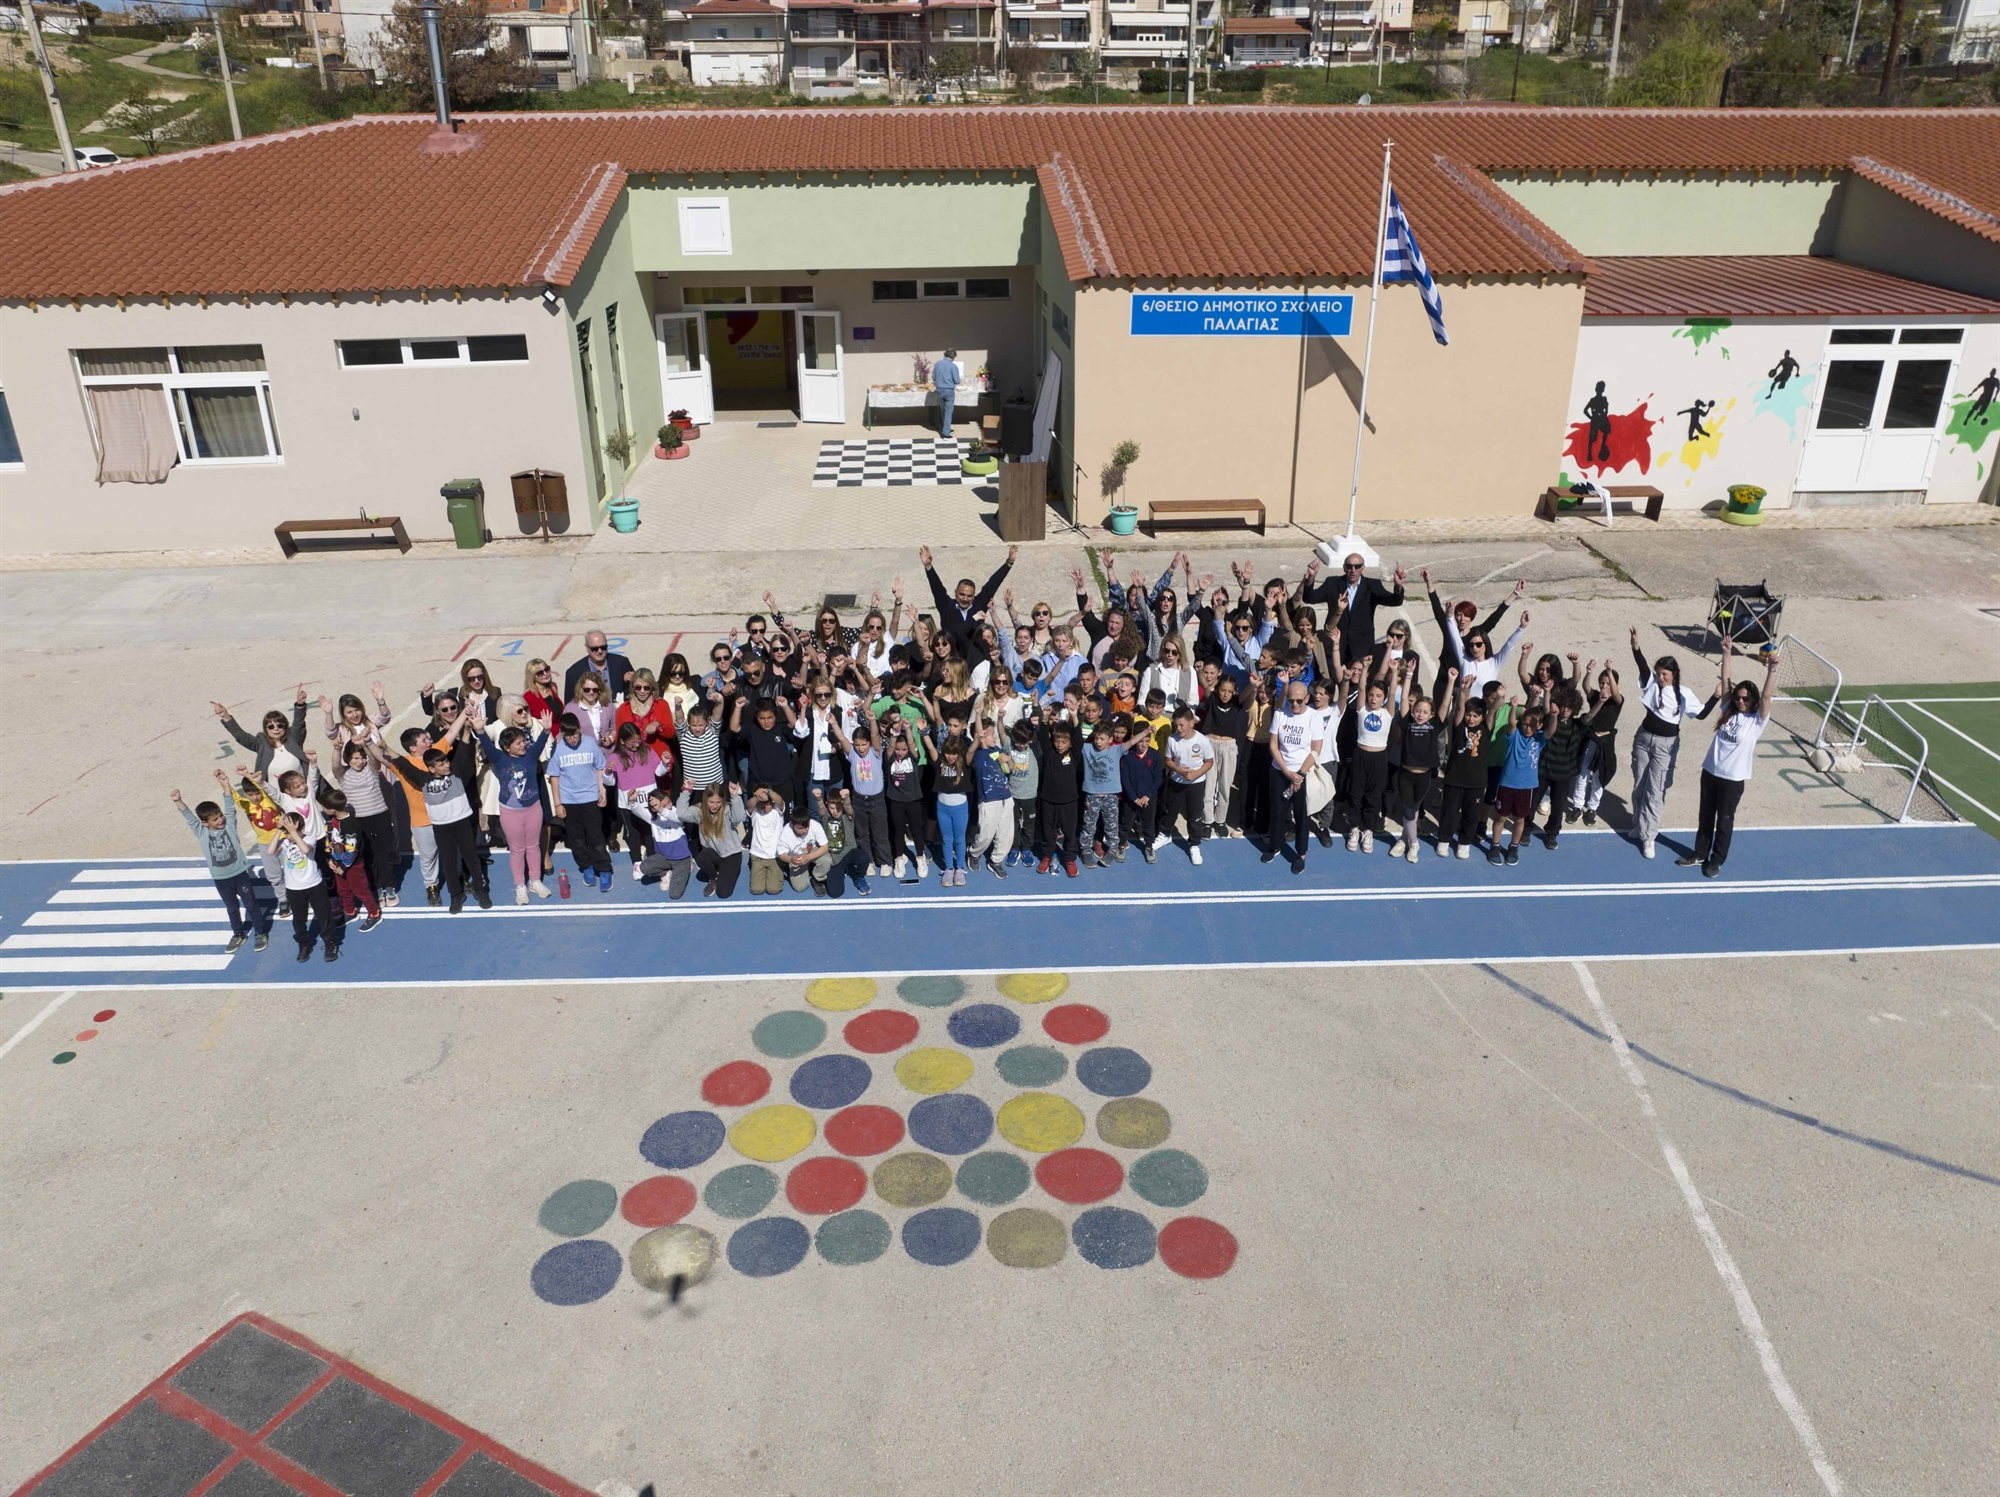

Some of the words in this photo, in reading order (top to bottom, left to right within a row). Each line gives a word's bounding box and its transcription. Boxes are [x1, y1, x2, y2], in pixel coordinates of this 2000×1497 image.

[1142, 300, 1199, 313] 6/ΘΕΣΙΟ
[1202, 300, 1277, 313] ΔΗΜΟΤΙΚΟ
[1281, 301, 1343, 313] ΣΧΟΛΕΙΟ
[1203, 317, 1280, 331] ΠΑΛΑΓΙΑΣ
[500, 639, 524, 657] 1
[1365, 717, 1381, 727] NASA
